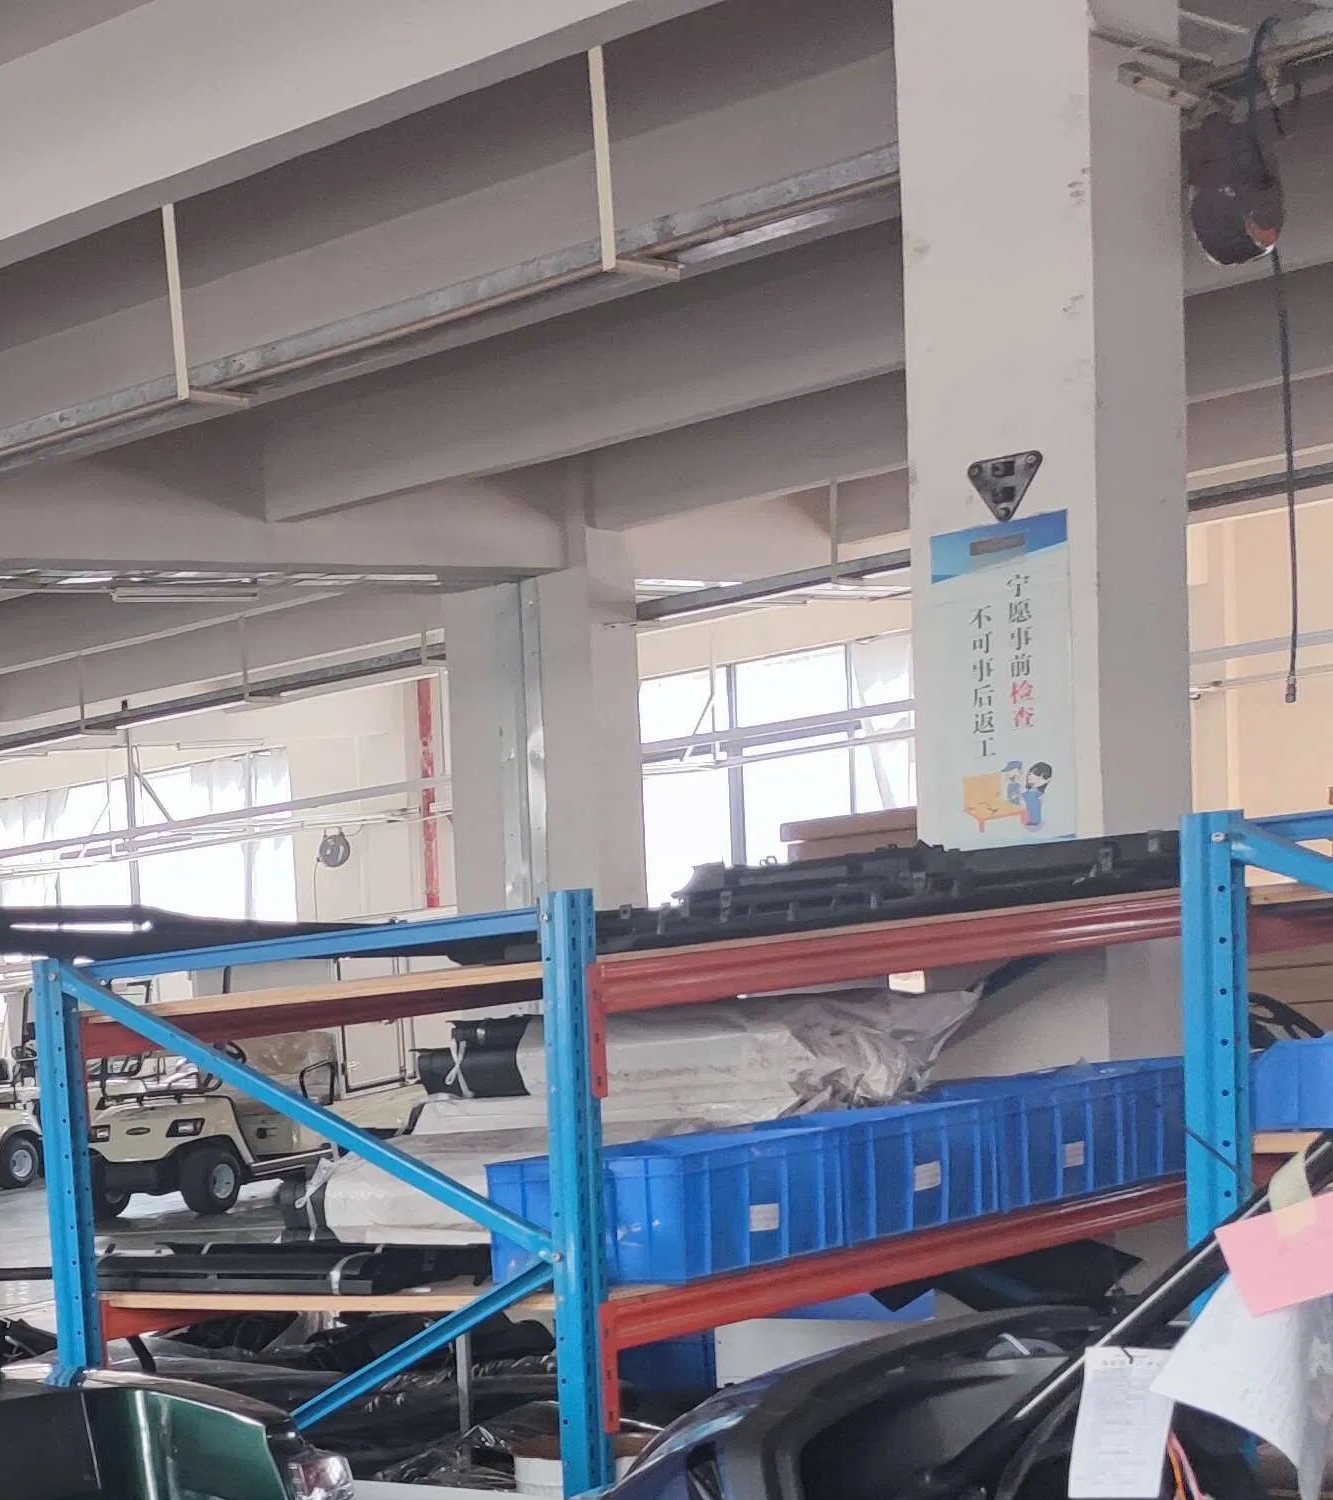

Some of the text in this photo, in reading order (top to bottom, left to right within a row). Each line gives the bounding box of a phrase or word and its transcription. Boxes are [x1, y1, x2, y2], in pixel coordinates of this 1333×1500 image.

[970, 604, 996, 760] 不可事后返工
[1007, 574, 1035, 730] 宁愿事前检查
